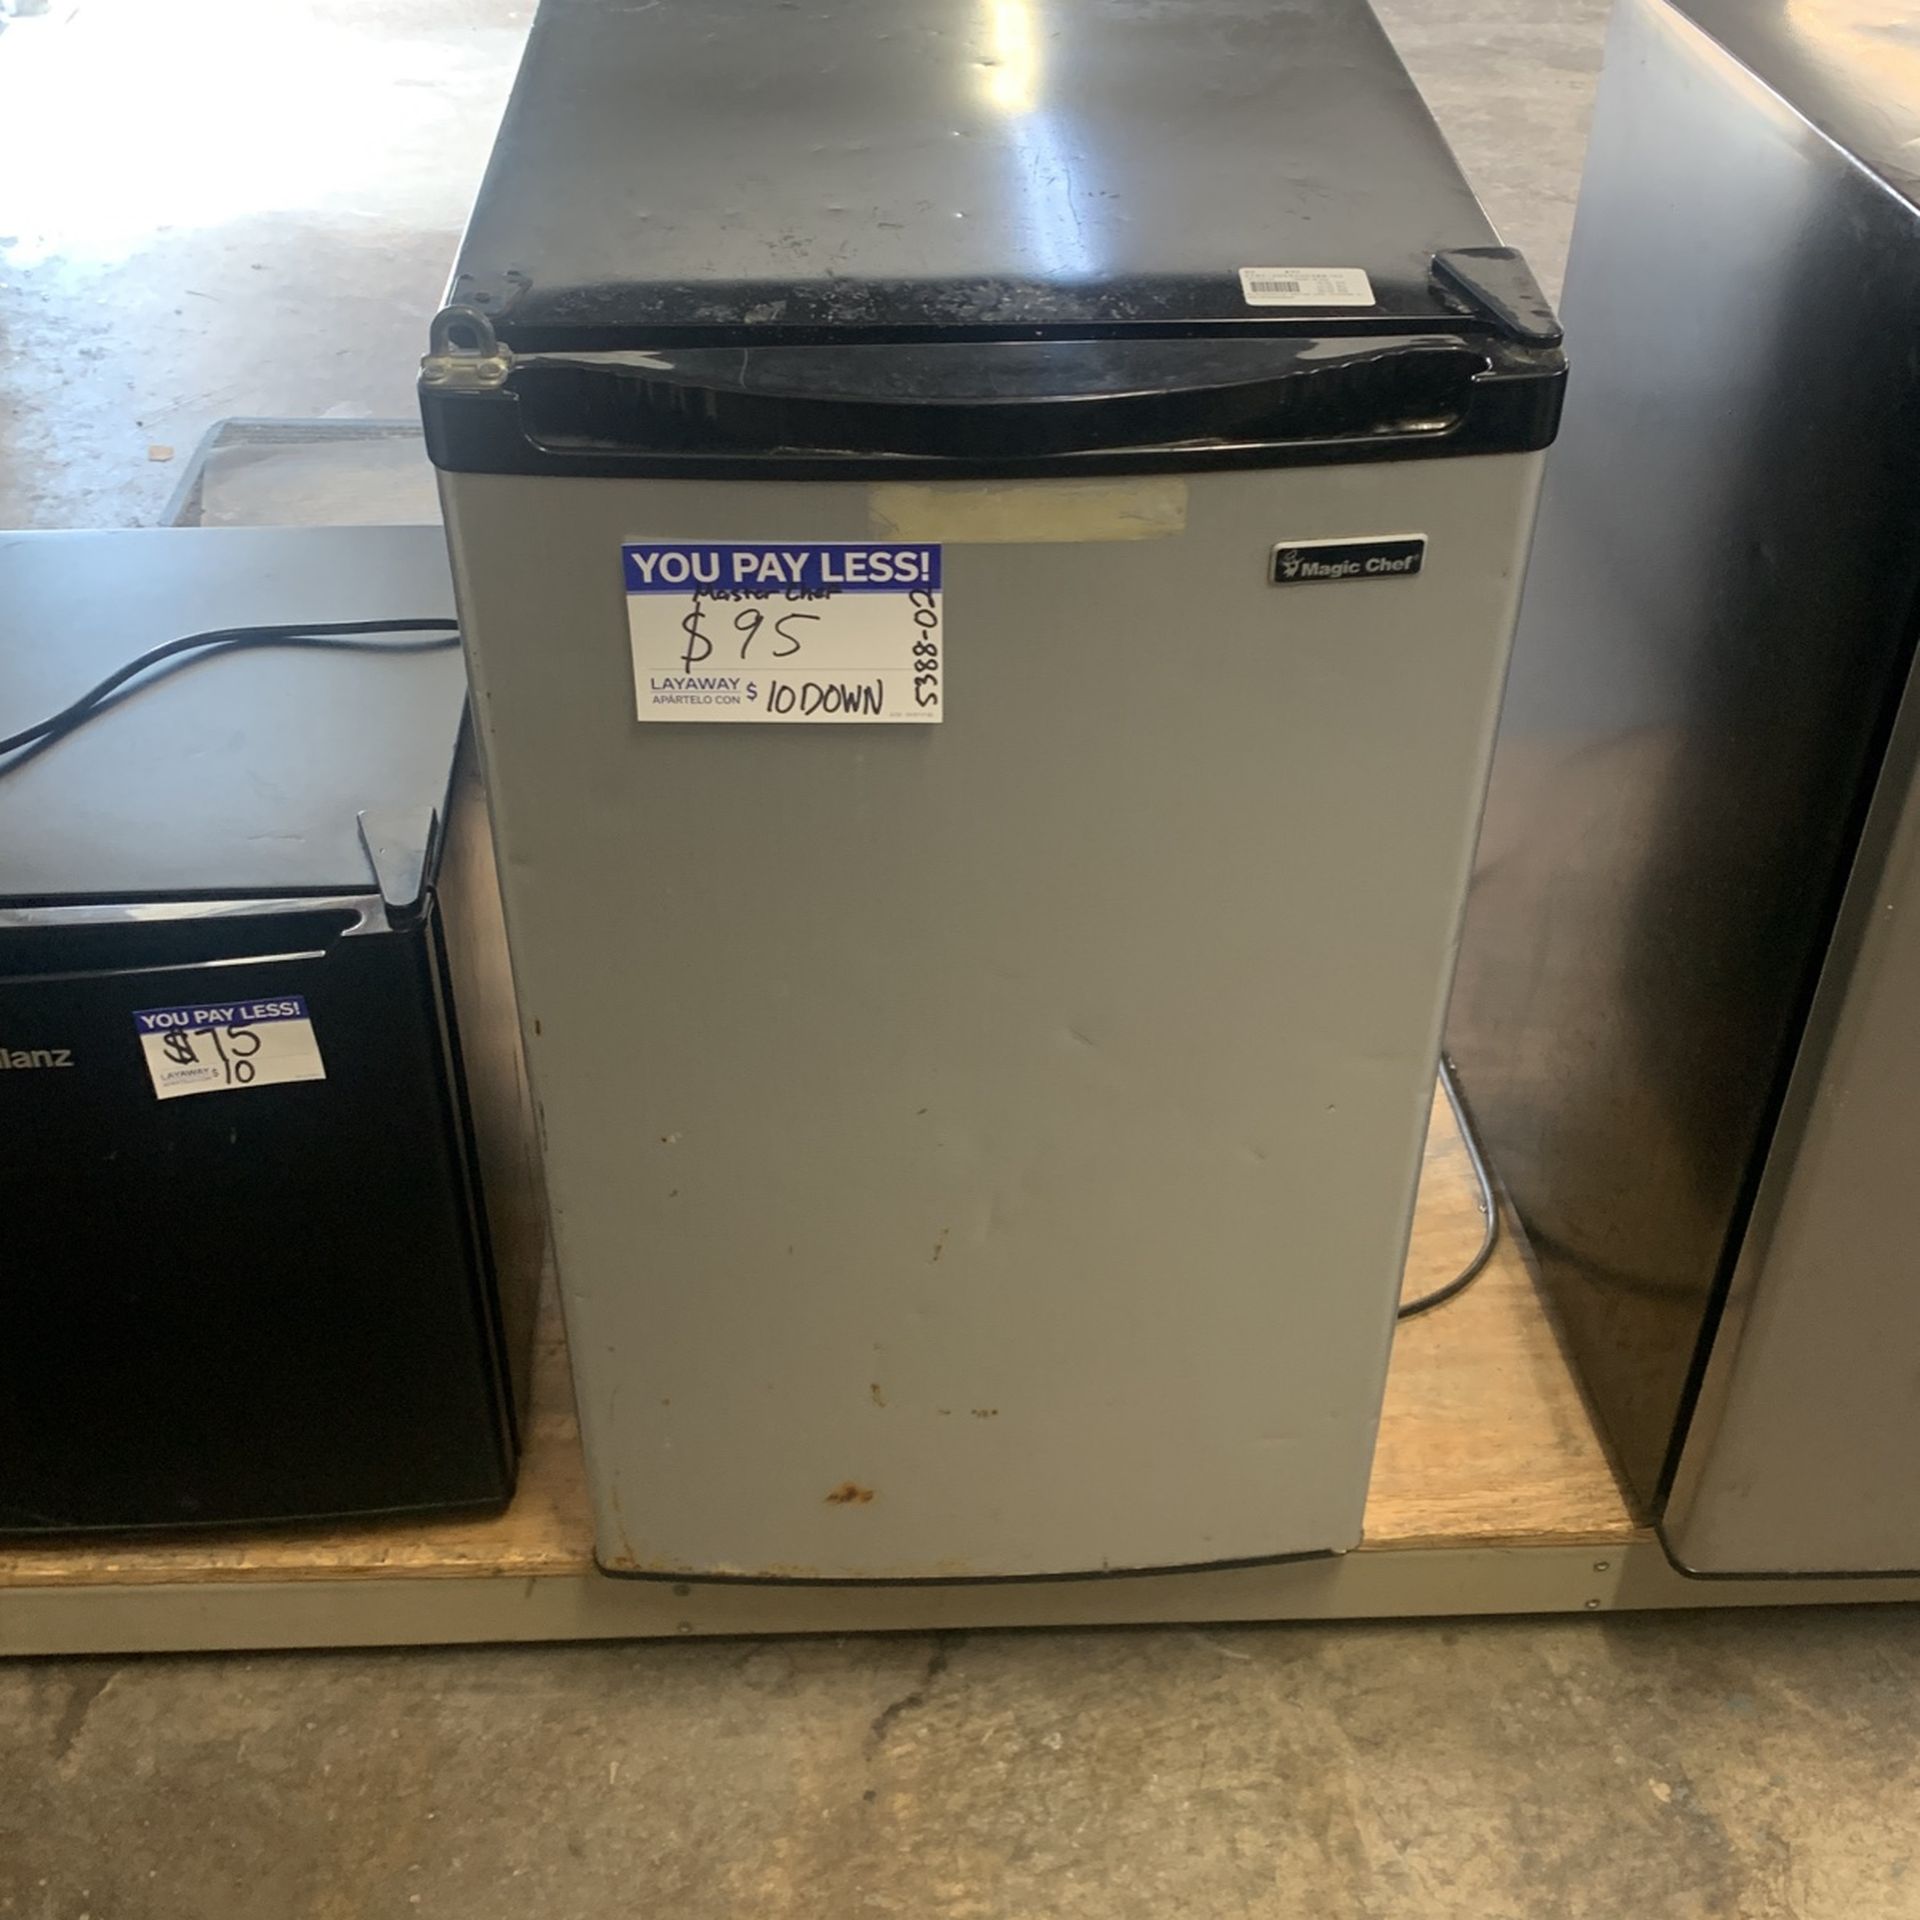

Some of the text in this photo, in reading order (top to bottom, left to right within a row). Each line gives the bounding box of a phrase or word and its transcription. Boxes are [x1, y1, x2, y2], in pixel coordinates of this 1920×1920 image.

[631, 551, 930, 583] YOU PAY LESS!
[1301, 555, 1413, 578] Magic Chef
[692, 583, 844, 602] Master Chef
[650, 677, 741, 690] LAYAWAY
[746, 681, 758, 701] $
[715, 693, 741, 705] CON
[140, 1001, 301, 1029] YOU PAY LESS!
[0, 1048, 74, 1069] lanz
